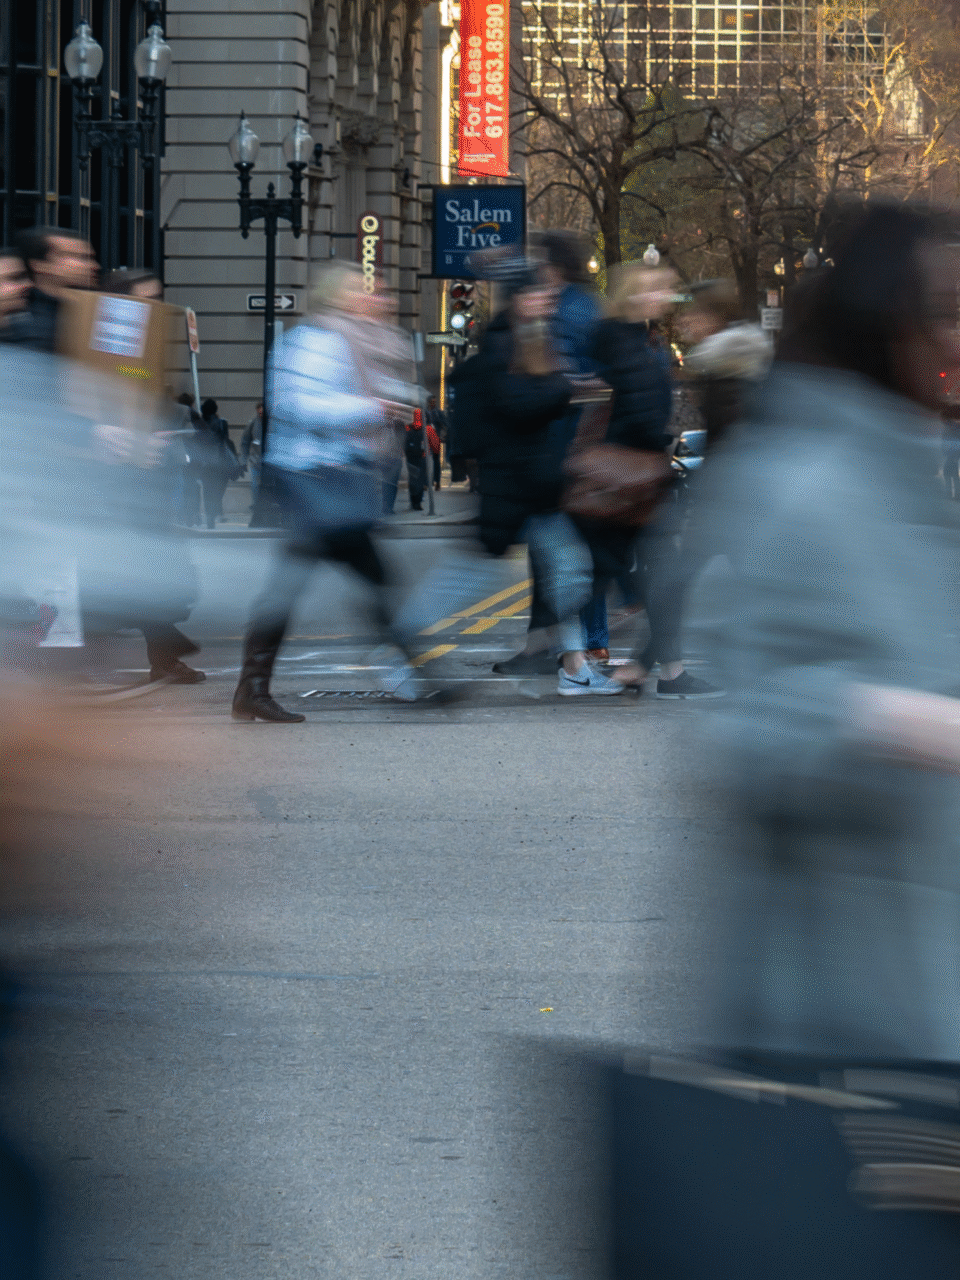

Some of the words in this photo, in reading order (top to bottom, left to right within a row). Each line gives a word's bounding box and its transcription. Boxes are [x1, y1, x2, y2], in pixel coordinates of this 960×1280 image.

[464, 35, 482, 97] Lease
[485, 3, 504, 138] 617.863.8590
[463, 103, 481, 137] For
[445, 199, 512, 222] Salem
[456, 224, 501, 247] Five
